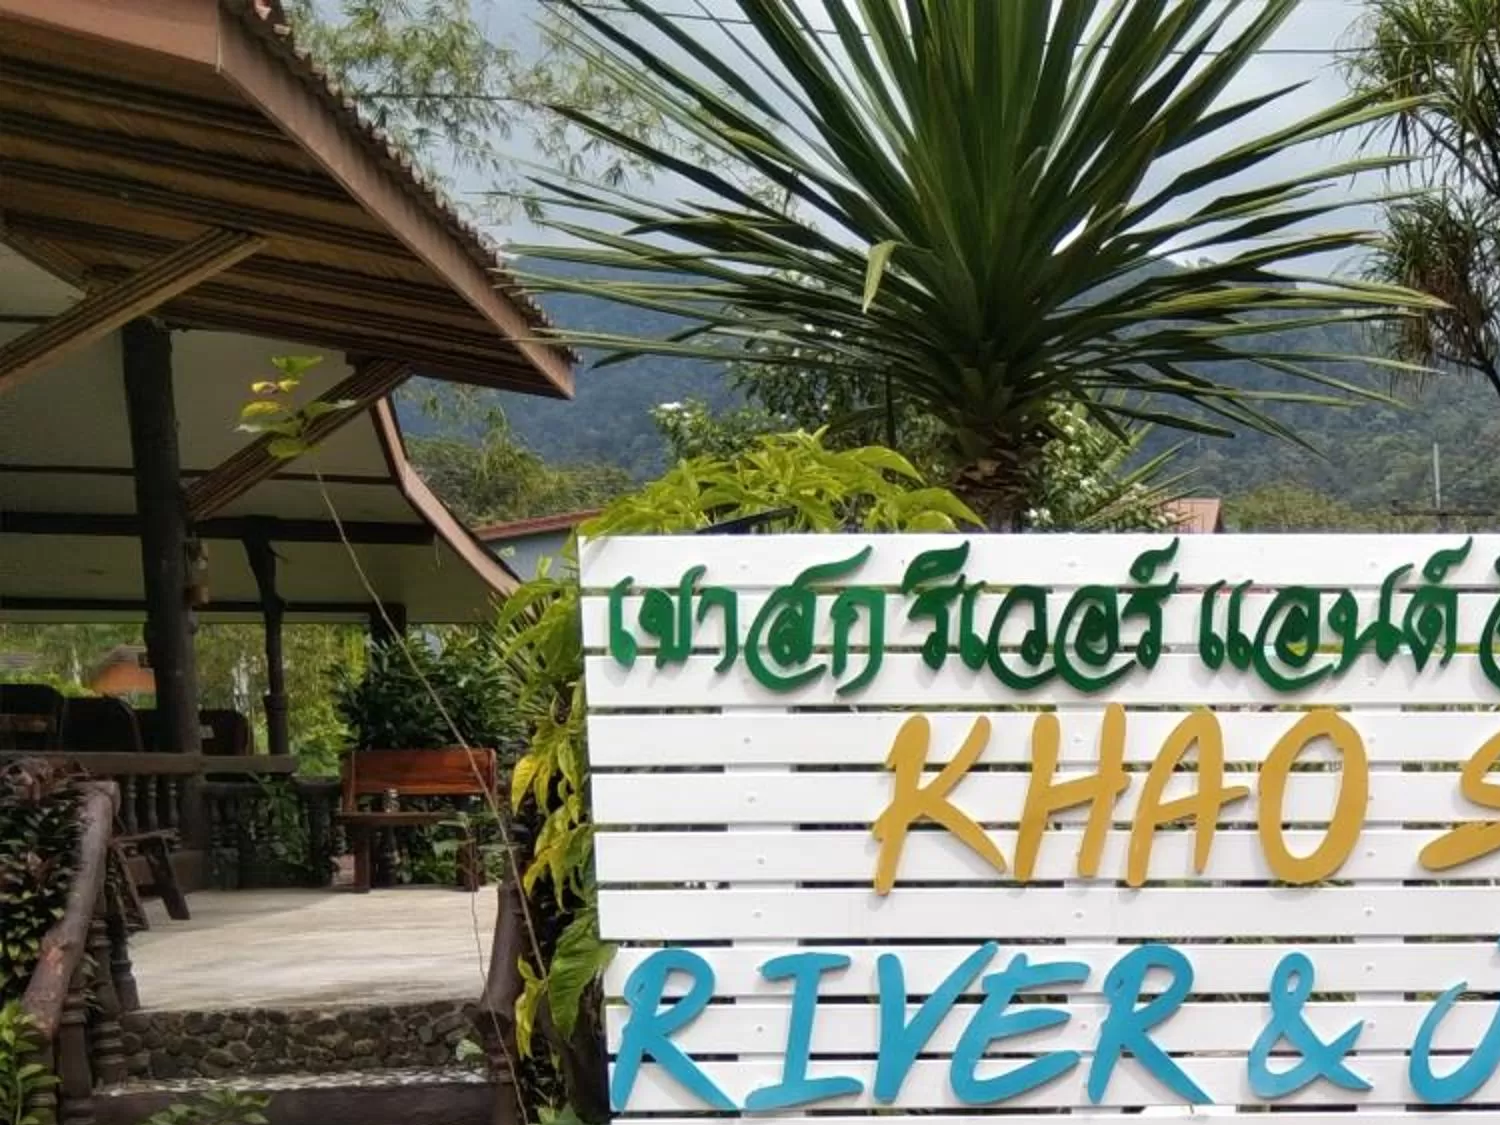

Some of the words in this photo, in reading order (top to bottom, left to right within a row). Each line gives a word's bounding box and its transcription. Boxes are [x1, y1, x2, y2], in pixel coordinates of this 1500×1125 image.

[871, 702, 1369, 894] KHAO
[608, 941, 1216, 1111] RIVER
[1247, 952, 1374, 1098] &
